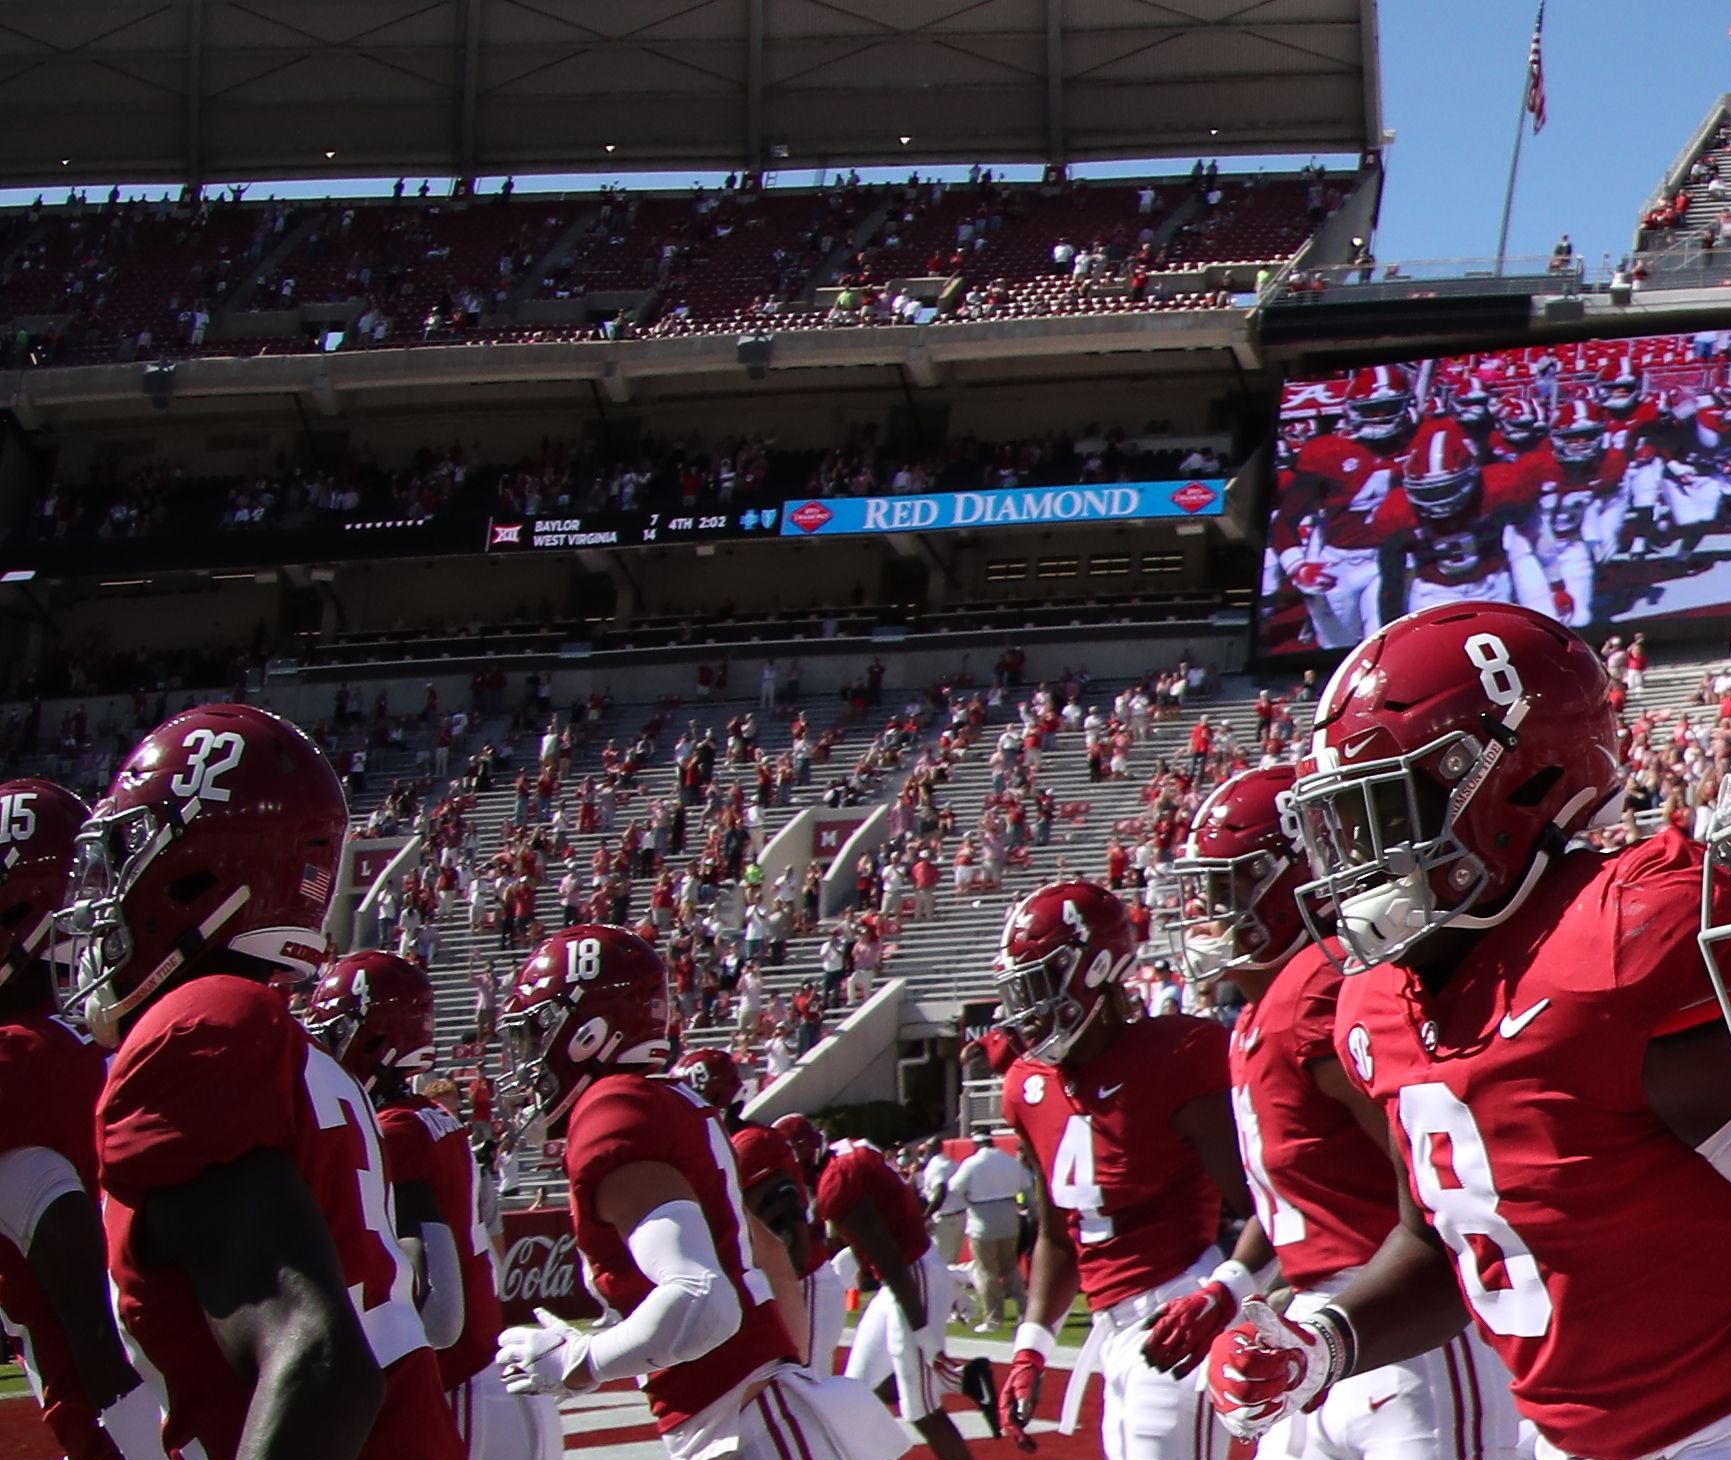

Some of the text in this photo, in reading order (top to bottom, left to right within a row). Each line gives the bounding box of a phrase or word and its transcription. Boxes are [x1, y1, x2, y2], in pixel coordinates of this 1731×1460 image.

[534, 519, 581, 532] BAYLOR
[650, 515, 660, 525] 7
[668, 515, 727, 530] 4TH 2:02
[863, 488, 1139, 531] RED DIAMOND
[534, 531, 618, 547] WEST VIRGINIA
[642, 529, 657, 541] 14
[1434, 534, 1478, 577] 3
[1465, 632, 1524, 706] 8
[171, 729, 245, 802] 32
[820, 829, 839, 848] M
[361, 856, 372, 878] L
[1062, 899, 1090, 942] 4
[158, 956, 177, 979] TIDE
[565, 938, 601, 984] 18
[351, 969, 370, 1006] 4
[1051, 1115, 1114, 1244] 4
[1400, 1082, 1553, 1337] 8
[501, 1234, 575, 1302] Cola
